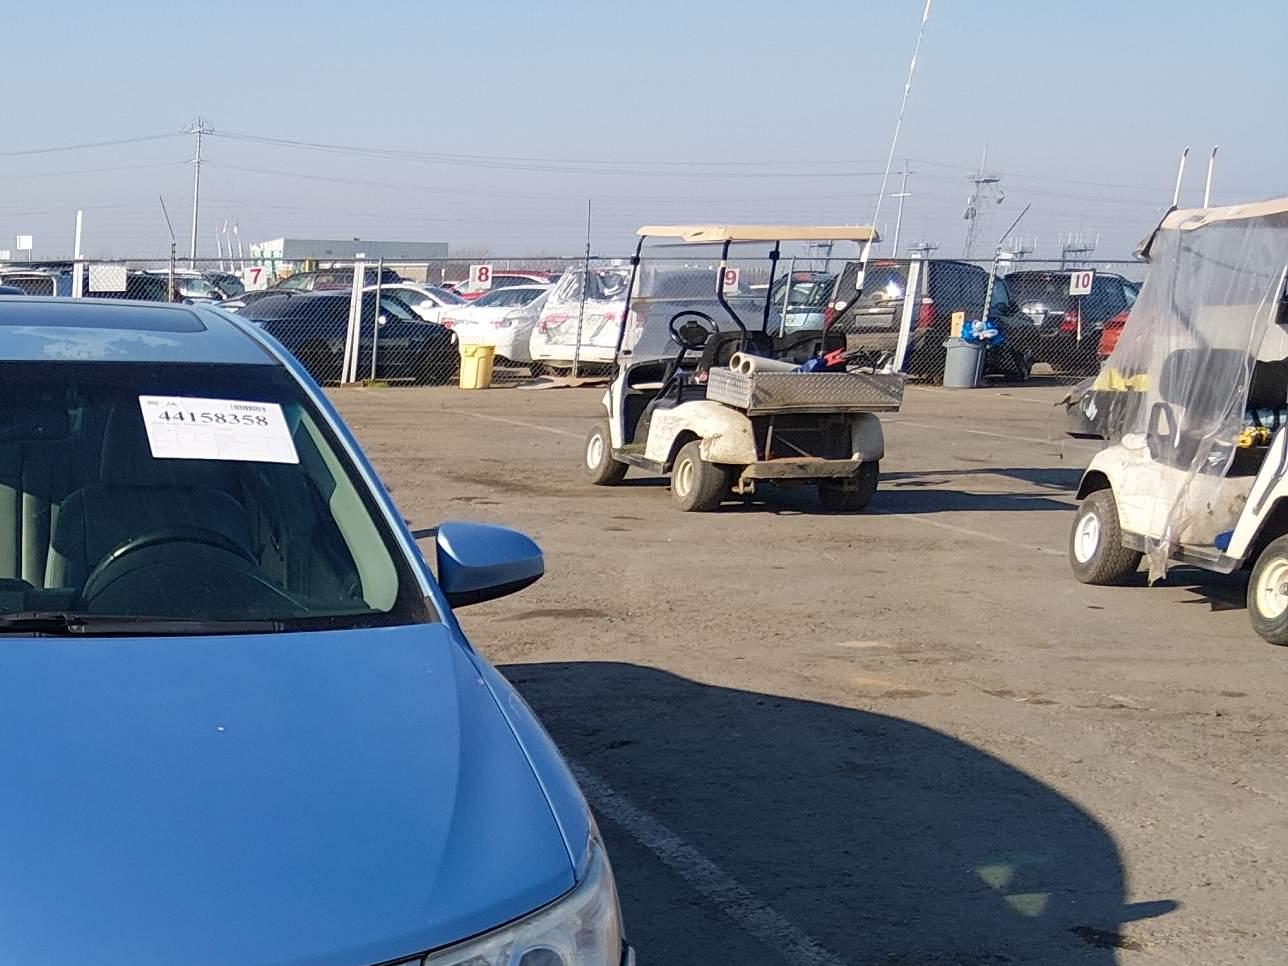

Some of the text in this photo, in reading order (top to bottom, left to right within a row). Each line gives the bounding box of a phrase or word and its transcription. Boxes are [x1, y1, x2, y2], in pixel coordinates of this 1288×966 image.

[250, 268, 262, 284] 7
[478, 266, 489, 283] 8
[725, 270, 737, 286] 9
[1075, 273, 1091, 289] 10
[158, 410, 269, 427] 44158358
